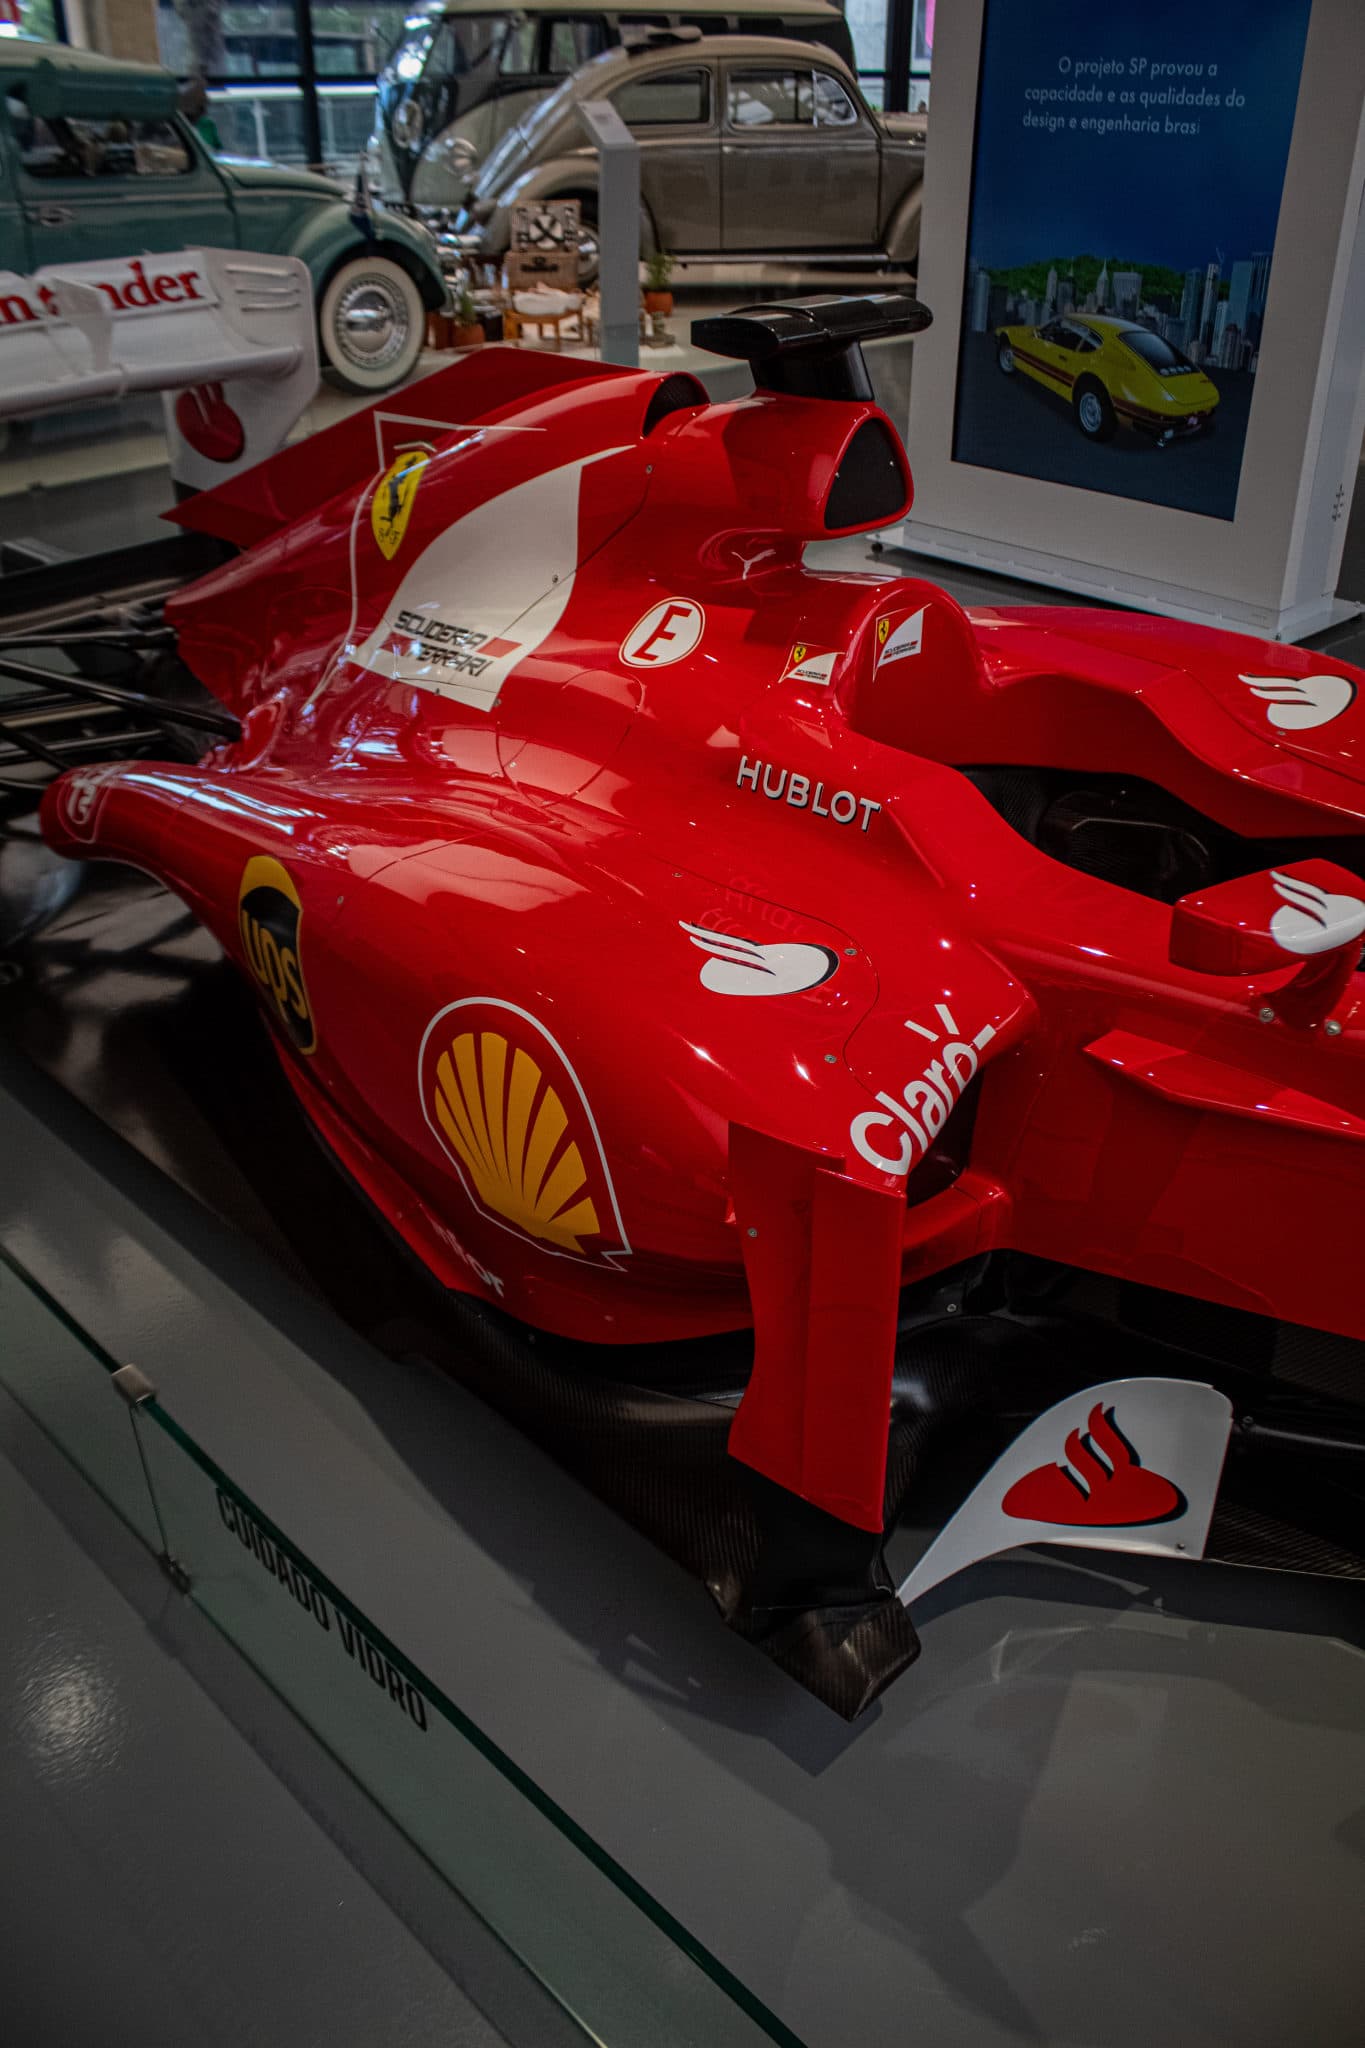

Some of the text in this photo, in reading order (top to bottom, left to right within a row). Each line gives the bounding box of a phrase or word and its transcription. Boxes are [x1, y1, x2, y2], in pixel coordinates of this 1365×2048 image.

[1024, 84, 1246, 109] capacidade e as qualidades do
[1058, 56, 1218, 80] O projeto SP provou a
[1022, 109, 1065, 132] design
[1069, 116, 1077, 128] e
[1080, 113, 1160, 135] engenharia
[736, 754, 882, 833] HUBLOT
[241, 908, 309, 1025] ups
[850, 1041, 978, 1176] Claro
[216, 1486, 428, 1733] CUIDADO VIDRO
